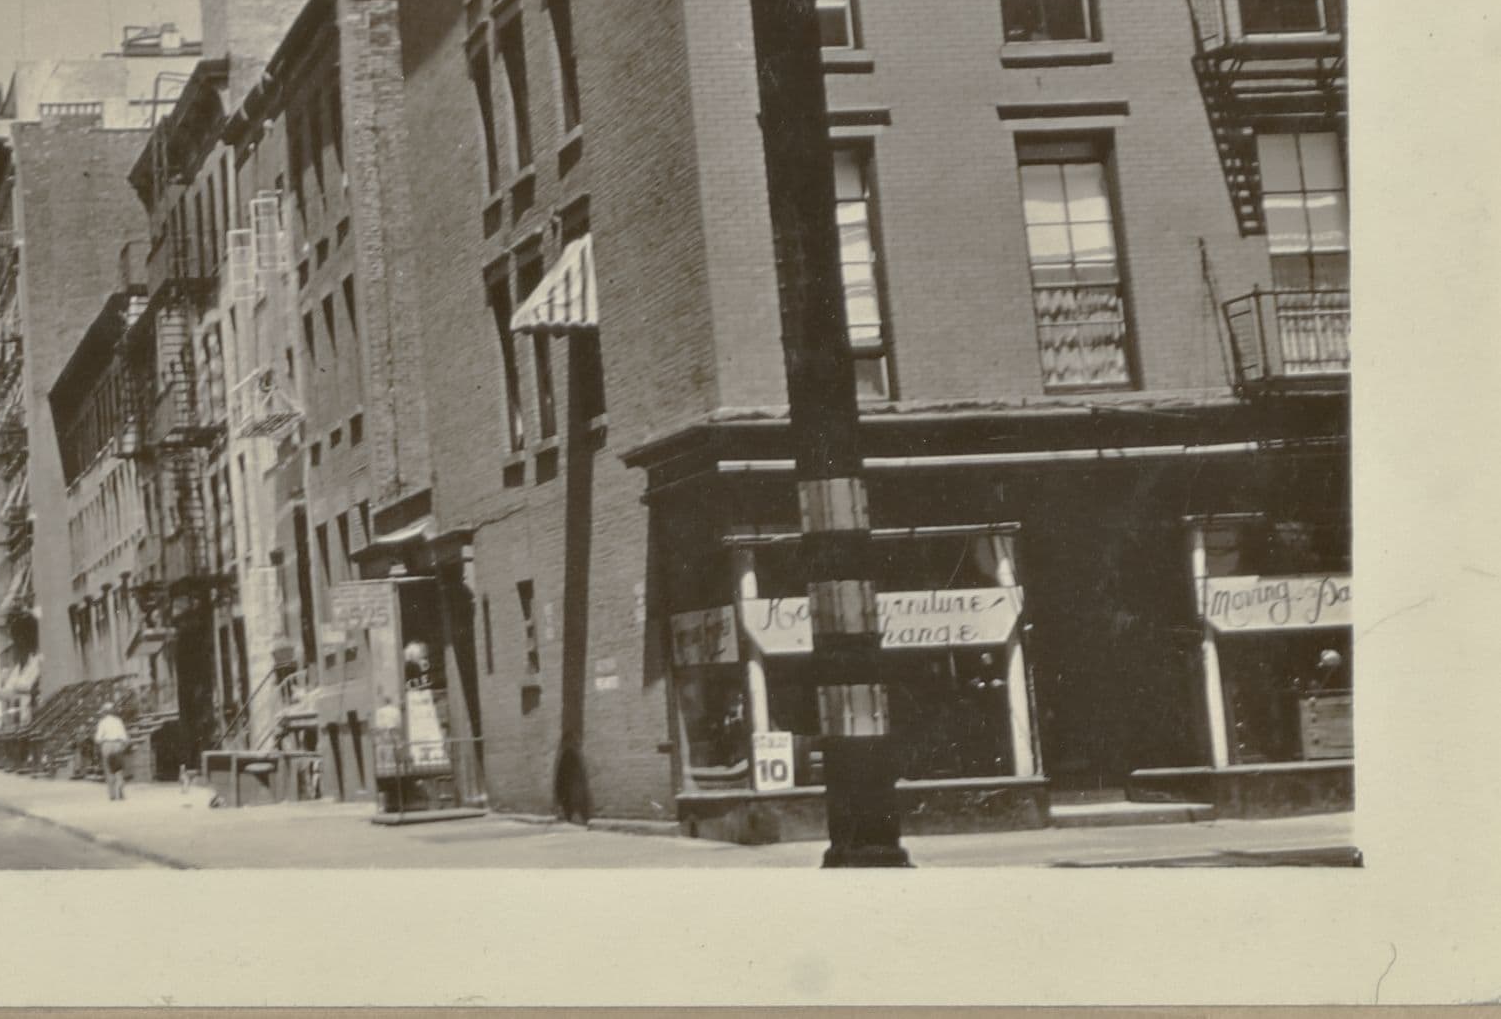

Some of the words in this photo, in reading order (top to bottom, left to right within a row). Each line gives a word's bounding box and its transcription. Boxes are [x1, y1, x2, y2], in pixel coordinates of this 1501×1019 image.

[875, 590, 999, 615] urniture
[1210, 581, 1292, 627] Moving
[756, 758, 789, 783] 10
